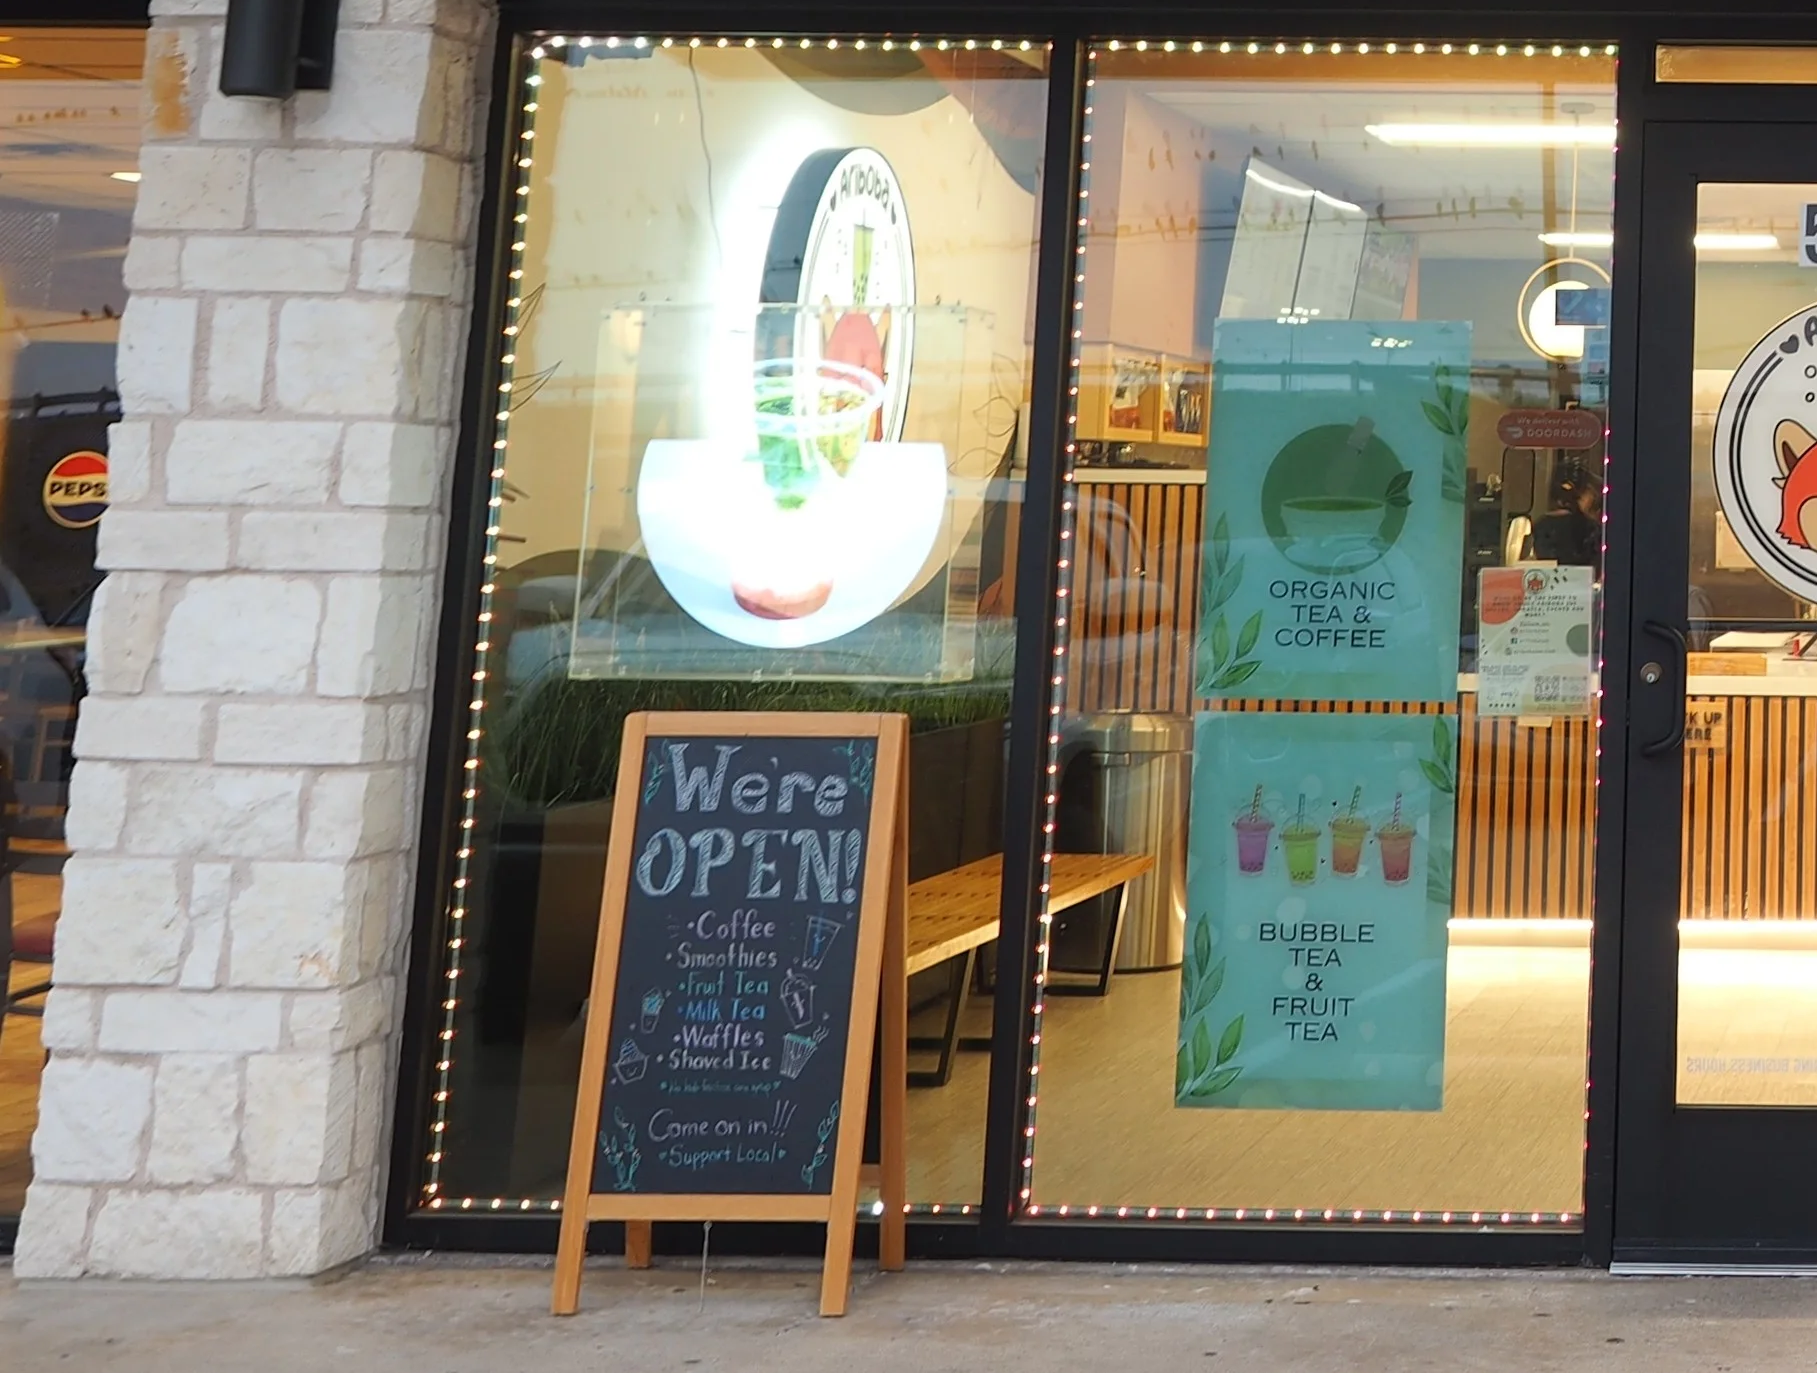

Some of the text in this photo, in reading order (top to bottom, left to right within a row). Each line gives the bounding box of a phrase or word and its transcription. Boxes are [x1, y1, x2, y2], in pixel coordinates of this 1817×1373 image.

[50, 480, 107, 497] PEPS
[1269, 580, 1396, 600] ORGANIC
[1290, 604, 1372, 624] TEA &
[1274, 628, 1386, 648] COFFEE
[1704, 711, 1722, 725] UP
[668, 742, 849, 818] We're
[636, 827, 862, 905] OPEN!
[696, 908, 777, 940] Coffee
[1259, 922, 1375, 943] BUBBLE
[677, 941, 779, 969] Smoothies
[1288, 947, 1342, 967] TEA
[687, 970, 769, 996] Fruit Tea
[1304, 972, 1323, 992] &
[685, 997, 766, 1023] Milk Tea
[1272, 996, 1355, 1017] FRUIT
[682, 1022, 765, 1050] Waffles
[1284, 1021, 1339, 1042] TEA
[668, 1048, 772, 1071] Shaved Ice
[648, 1108, 709, 1142] Come
[714, 1119, 741, 1137] on
[668, 1141, 777, 1173] Support Local
